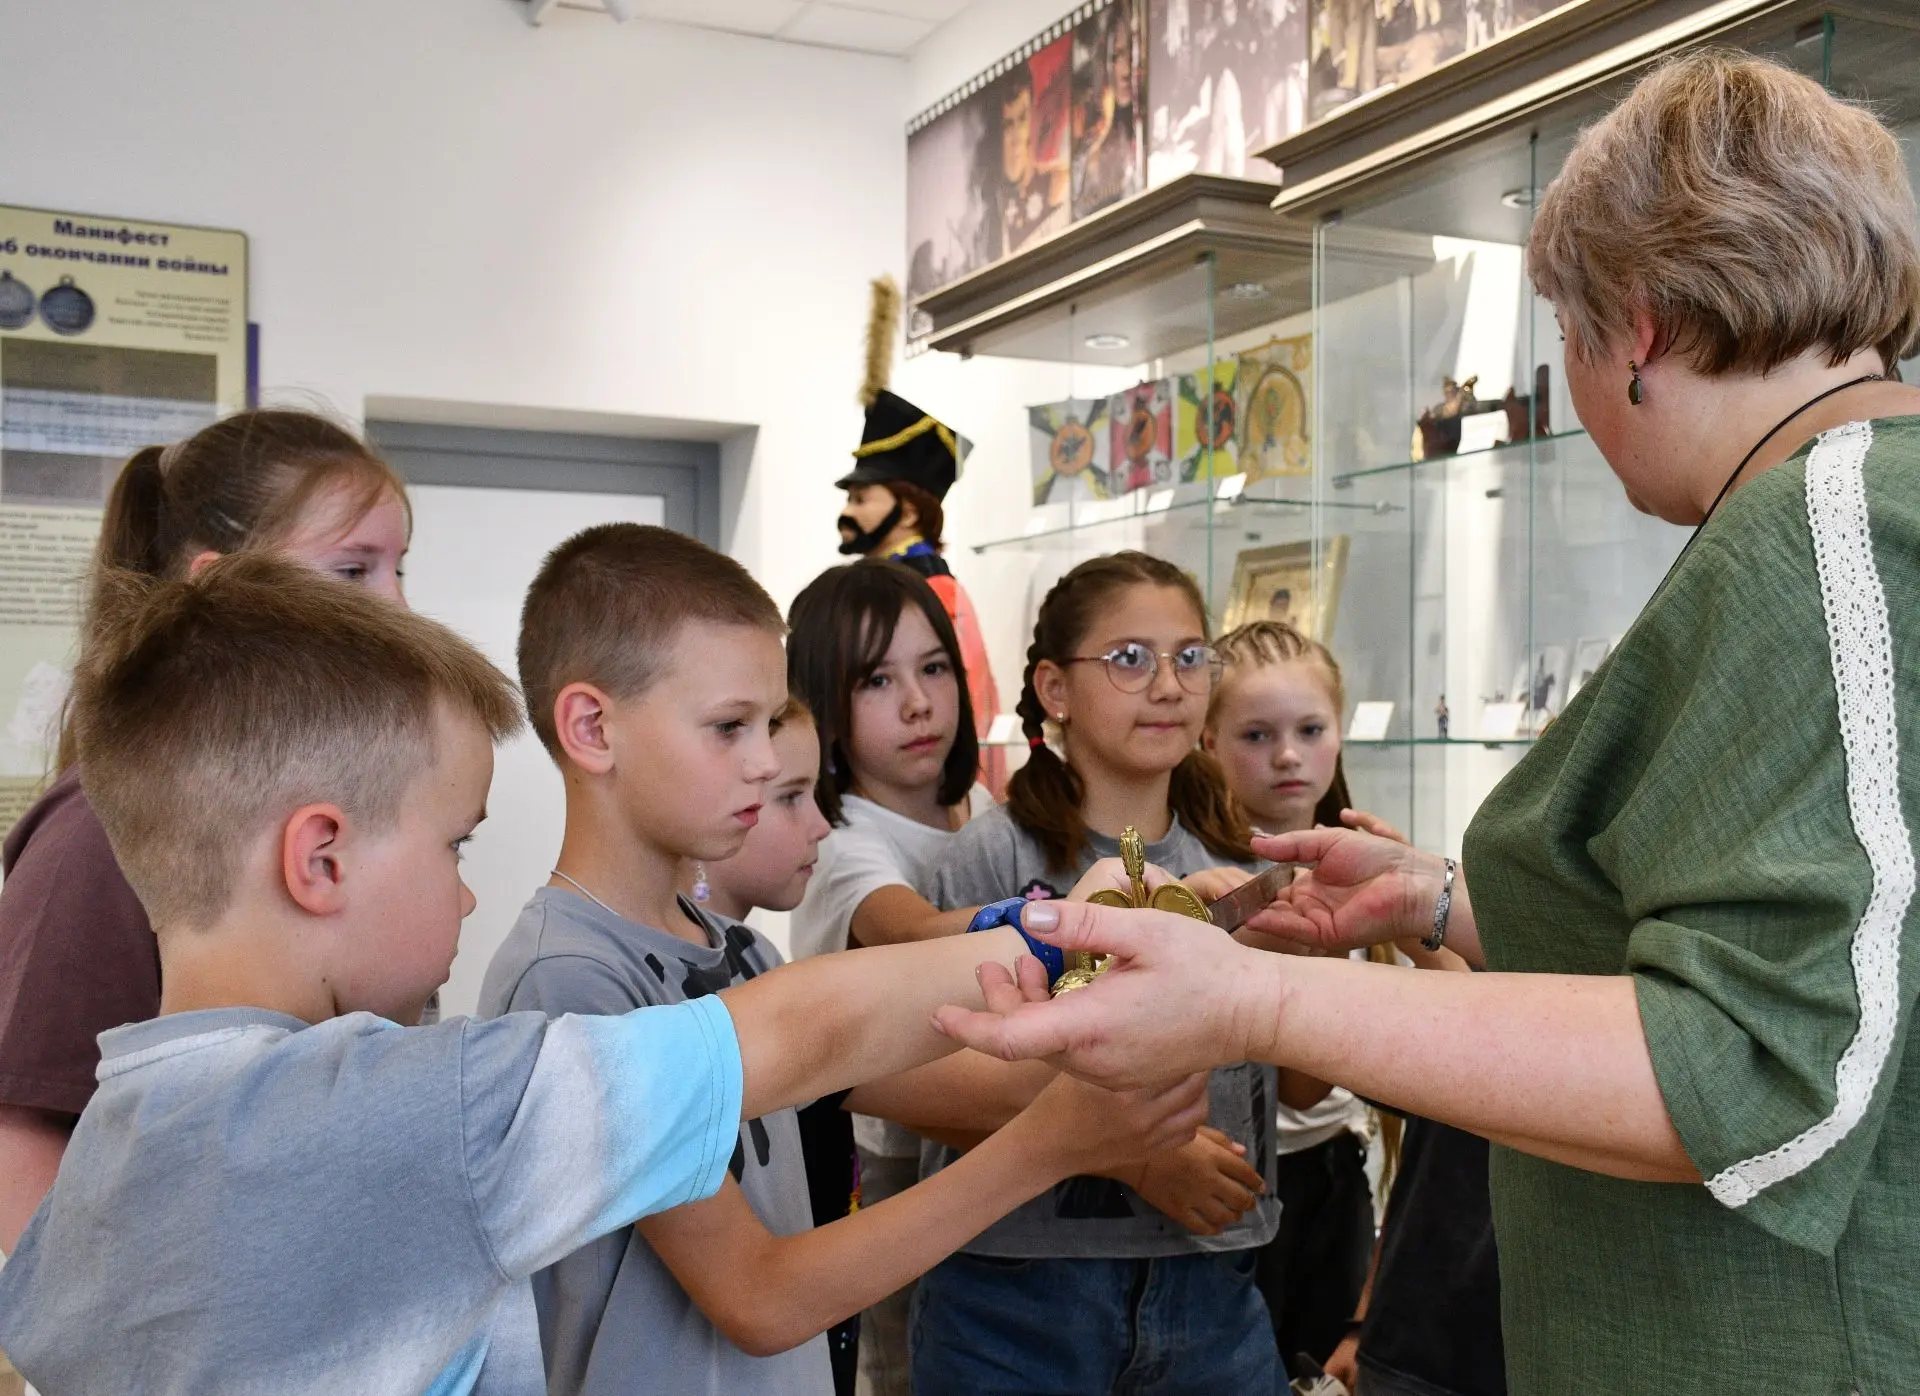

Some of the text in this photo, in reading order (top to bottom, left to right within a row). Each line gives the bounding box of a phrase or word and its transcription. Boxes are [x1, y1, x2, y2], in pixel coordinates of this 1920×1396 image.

[54, 219, 169, 246] Манифест
[26, 245, 150, 267] окончании
[157, 255, 228, 276] войны
